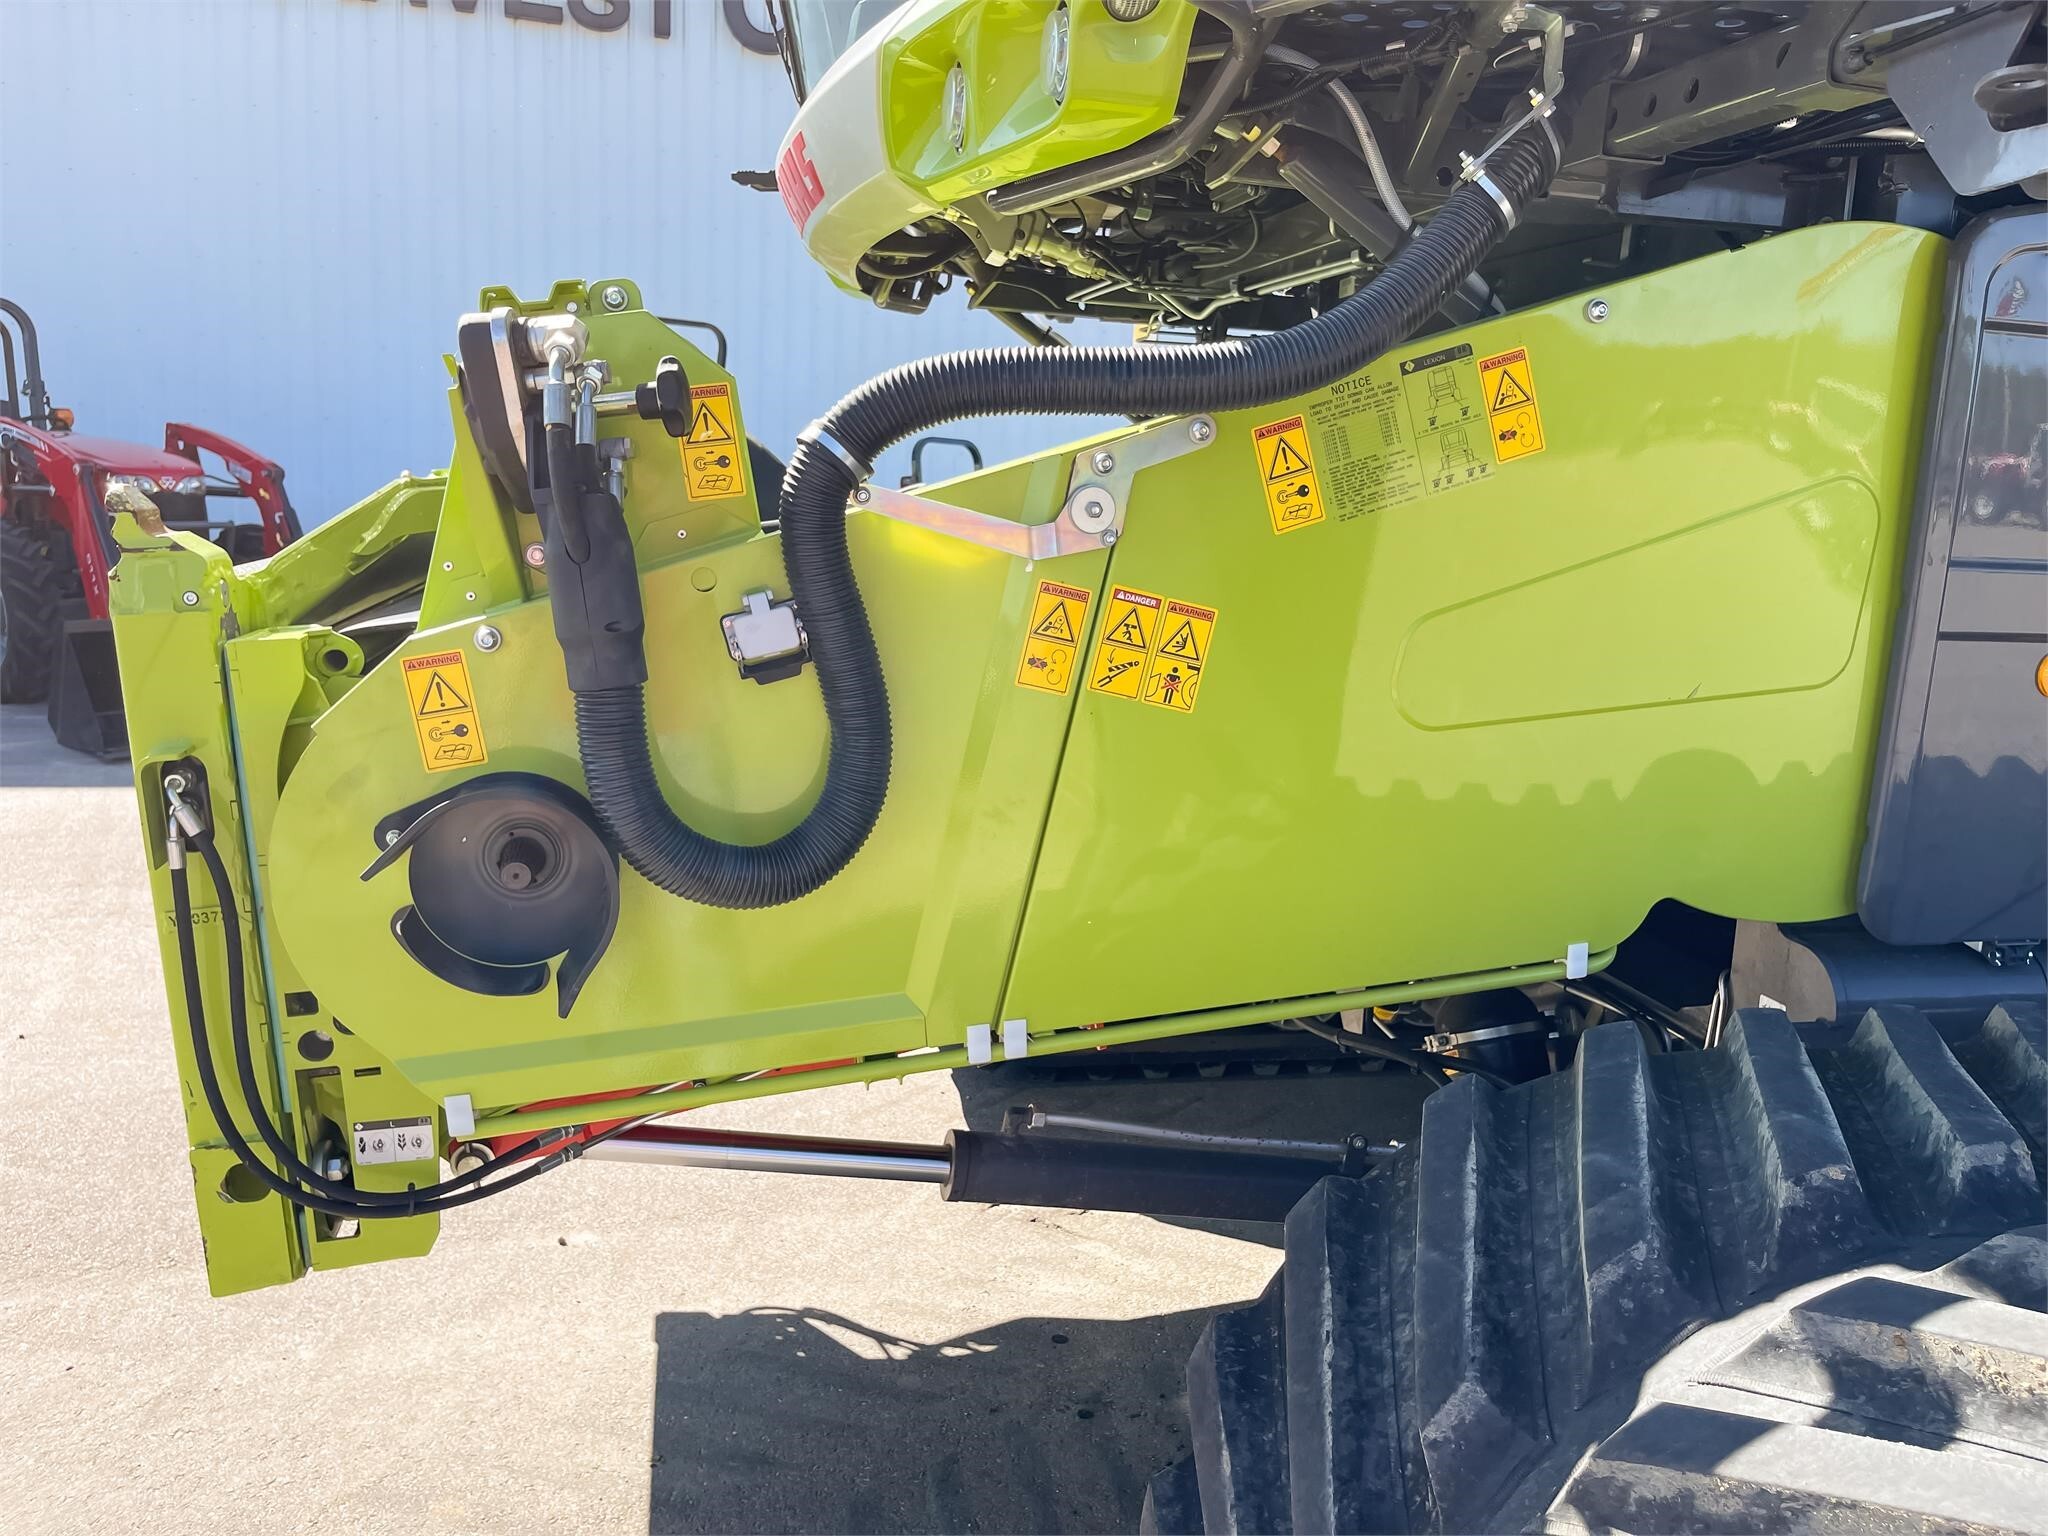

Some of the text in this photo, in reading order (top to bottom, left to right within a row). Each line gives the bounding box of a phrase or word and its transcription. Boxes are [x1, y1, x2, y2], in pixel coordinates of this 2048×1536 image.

[1423, 354, 1446, 366] LEXION
[1489, 352, 1524, 367] WARNING
[1331, 376, 1372, 396] NOTICE
[1263, 420, 1301, 437] WARNING
[1050, 586, 1087, 601] WARNING
[1124, 593, 1157, 607] DANGER
[1177, 605, 1213, 620] WARNING
[416, 654, 460, 668] WARNING
